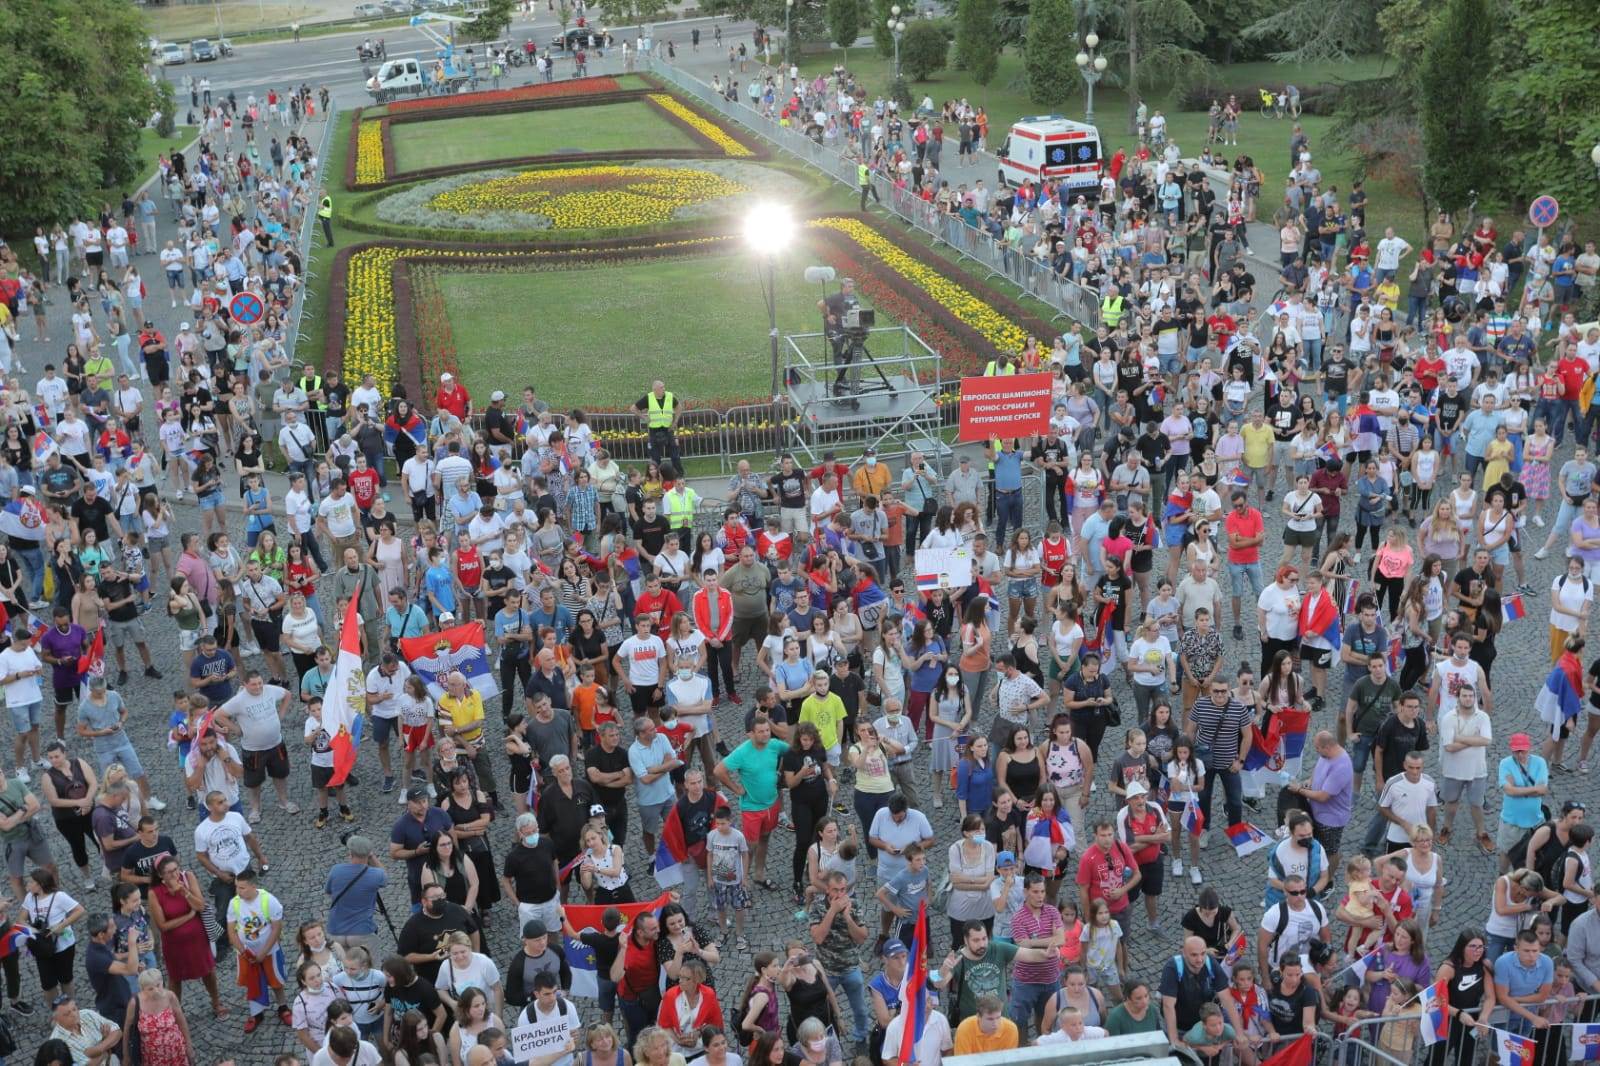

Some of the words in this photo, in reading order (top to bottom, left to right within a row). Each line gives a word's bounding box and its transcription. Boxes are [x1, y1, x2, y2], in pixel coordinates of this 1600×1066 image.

[963, 393, 1000, 401] ЕВРОПСКЕ
[1002, 389, 1050, 400] ШАМПИОНКЕ
[974, 404, 1000, 412] ПОНОС
[1002, 403, 1028, 411] СРБИЈЕ
[970, 415, 1013, 424] РЕПУБЛИКЕ
[1014, 412, 1041, 421] СРПСКЕ
[514, 1023, 568, 1043] КРАЉИЦЕ
[520, 1035, 564, 1051] СПОРТА
